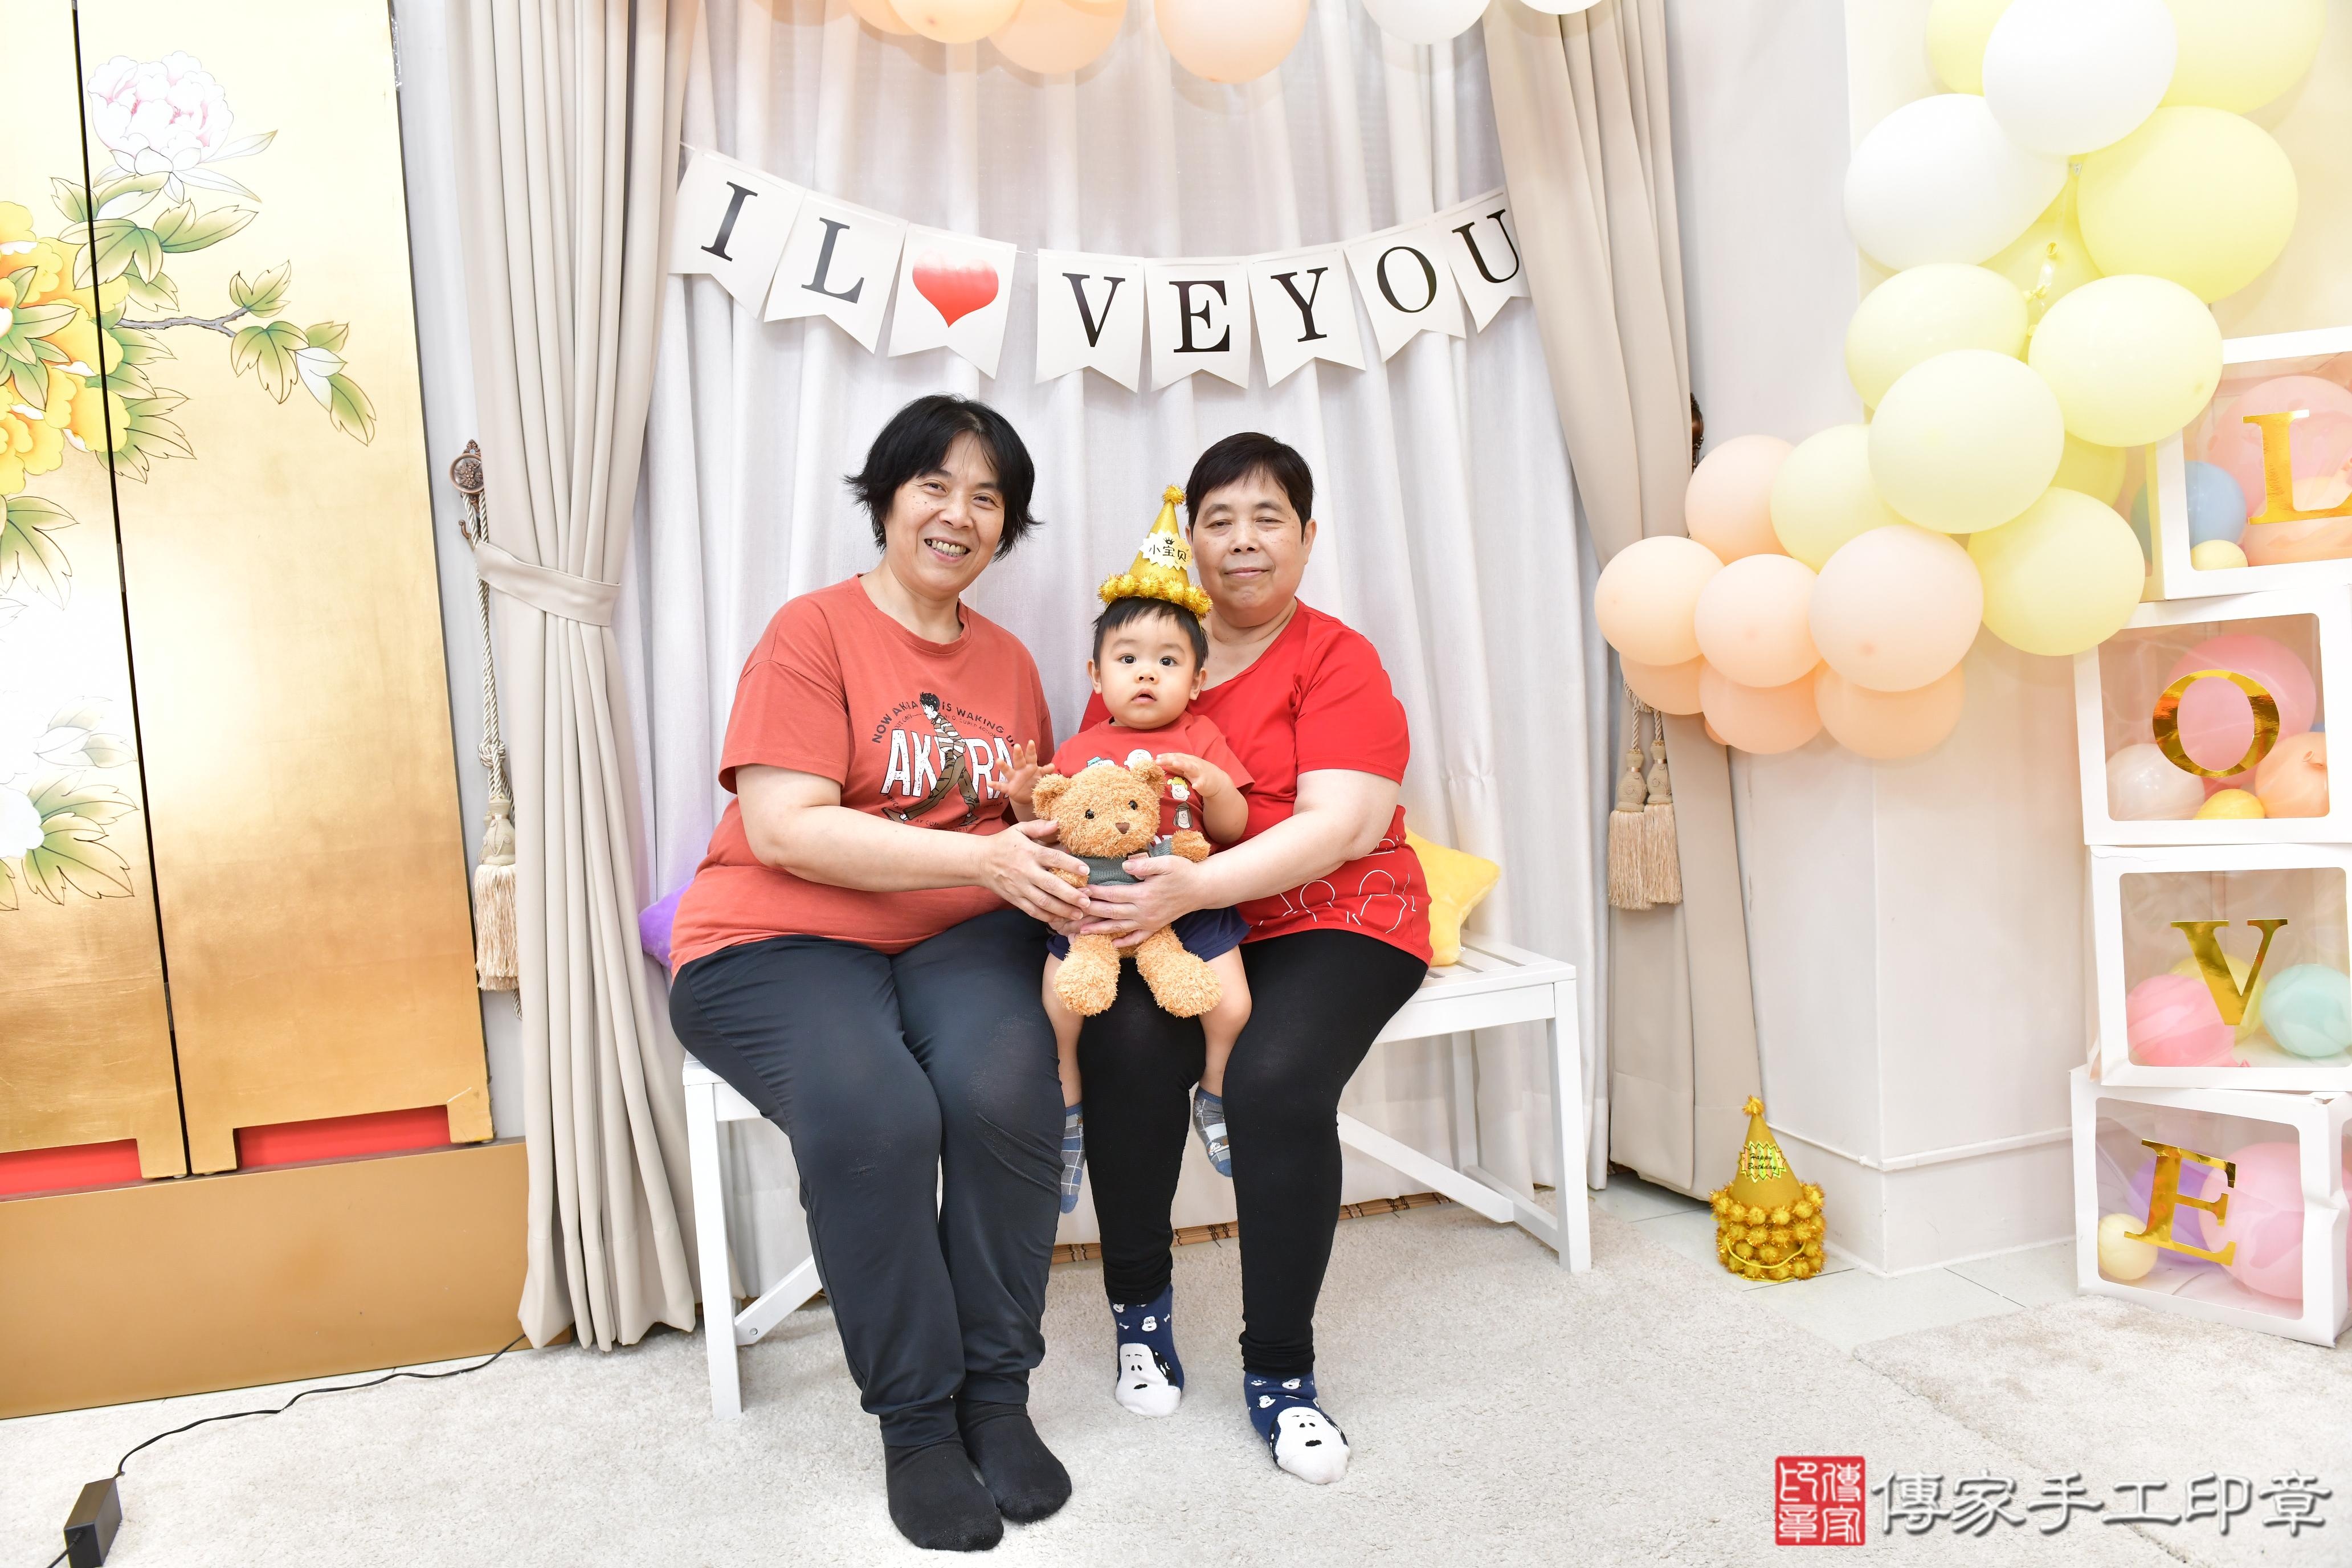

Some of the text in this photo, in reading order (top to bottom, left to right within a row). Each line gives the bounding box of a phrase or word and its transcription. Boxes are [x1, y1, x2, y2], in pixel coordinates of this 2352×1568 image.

[701, 181, 758, 262] I
[1148, 545, 1187, 562] 小宝贝
[872, 713, 892, 744] NOW
[892, 701, 918, 716] AKIRA
[942, 701, 952, 712] IS
[956, 707, 1004, 733] WAKING
[1006, 734, 1015, 747] U
[1749, 1153, 1773, 1162] Happy
[1747, 1162, 1777, 1171] Birthday
